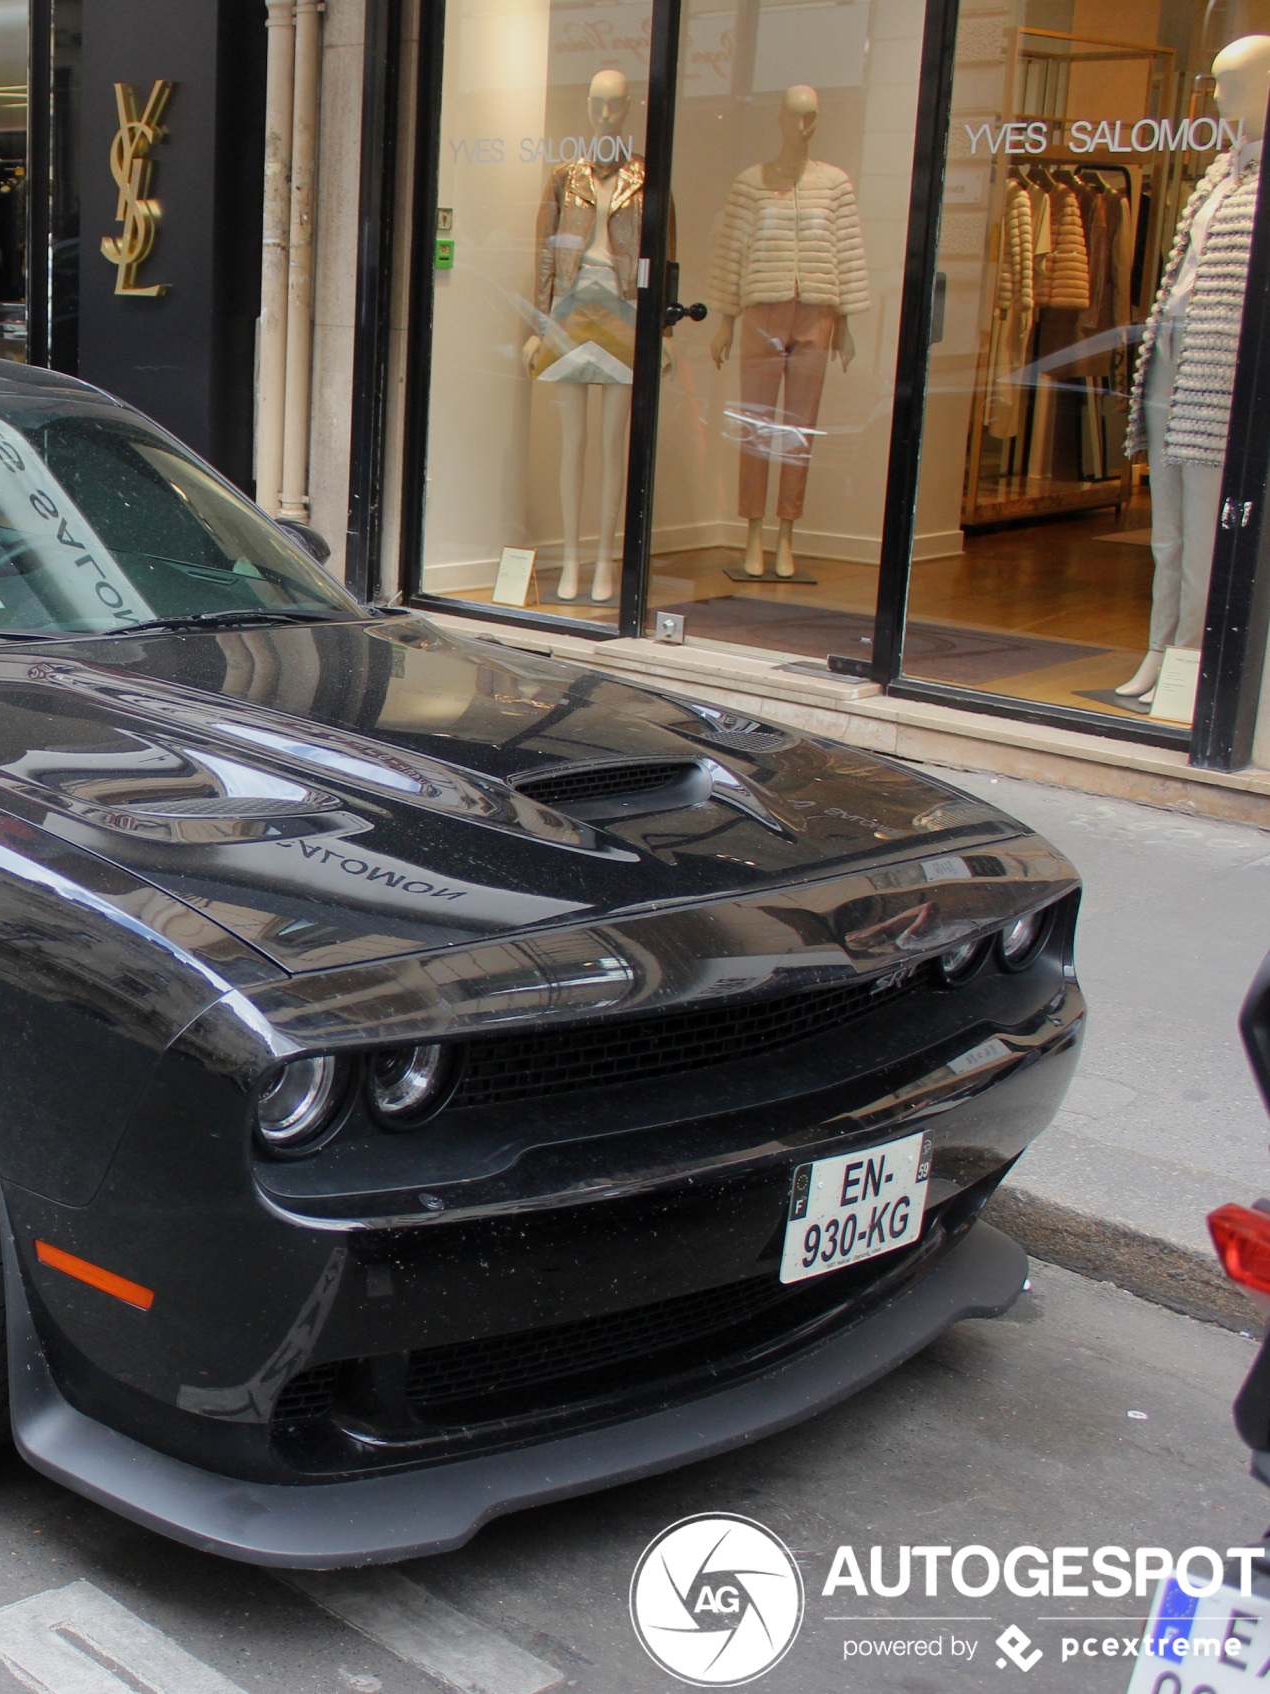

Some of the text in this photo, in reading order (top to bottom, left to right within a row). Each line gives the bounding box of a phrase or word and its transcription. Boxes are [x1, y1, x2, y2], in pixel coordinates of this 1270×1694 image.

[449, 135, 633, 164] YVES SALOMON
[964, 117, 1244, 154] YVES SALOMON
[871, 963, 917, 995] SRT
[840, 1154, 893, 1207] EN-
[917, 1162, 929, 1180] 59
[795, 1199, 804, 1214] F
[802, 1195, 910, 1268] 930-KG
